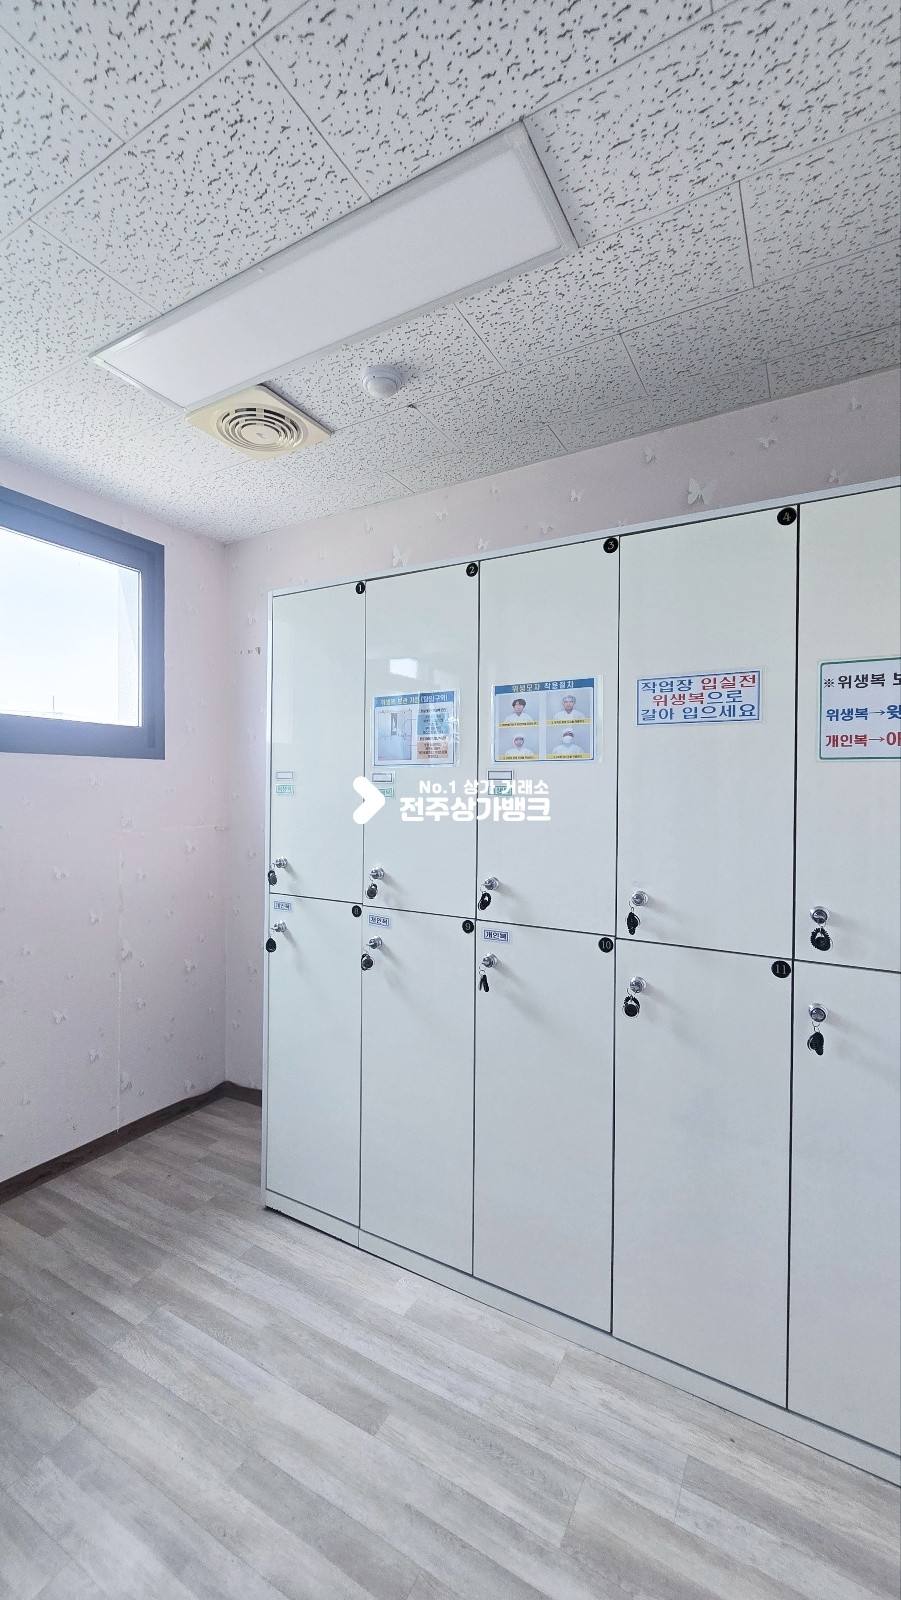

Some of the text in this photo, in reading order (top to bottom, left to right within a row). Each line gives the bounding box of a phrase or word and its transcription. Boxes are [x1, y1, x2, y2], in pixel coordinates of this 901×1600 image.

[782, 511, 792, 522] 4
[641, 674, 756, 694] 작업장 입실전
[652, 690, 743, 707] 위생복으로
[641, 704, 756, 721] 갈아 입으세요
[826, 707, 869, 721] 위생복
[825, 734, 868, 748] 개인복
[485, 931, 507, 940] 개인복
[601, 940, 611, 949] 10
[776, 964, 786, 975] 11
